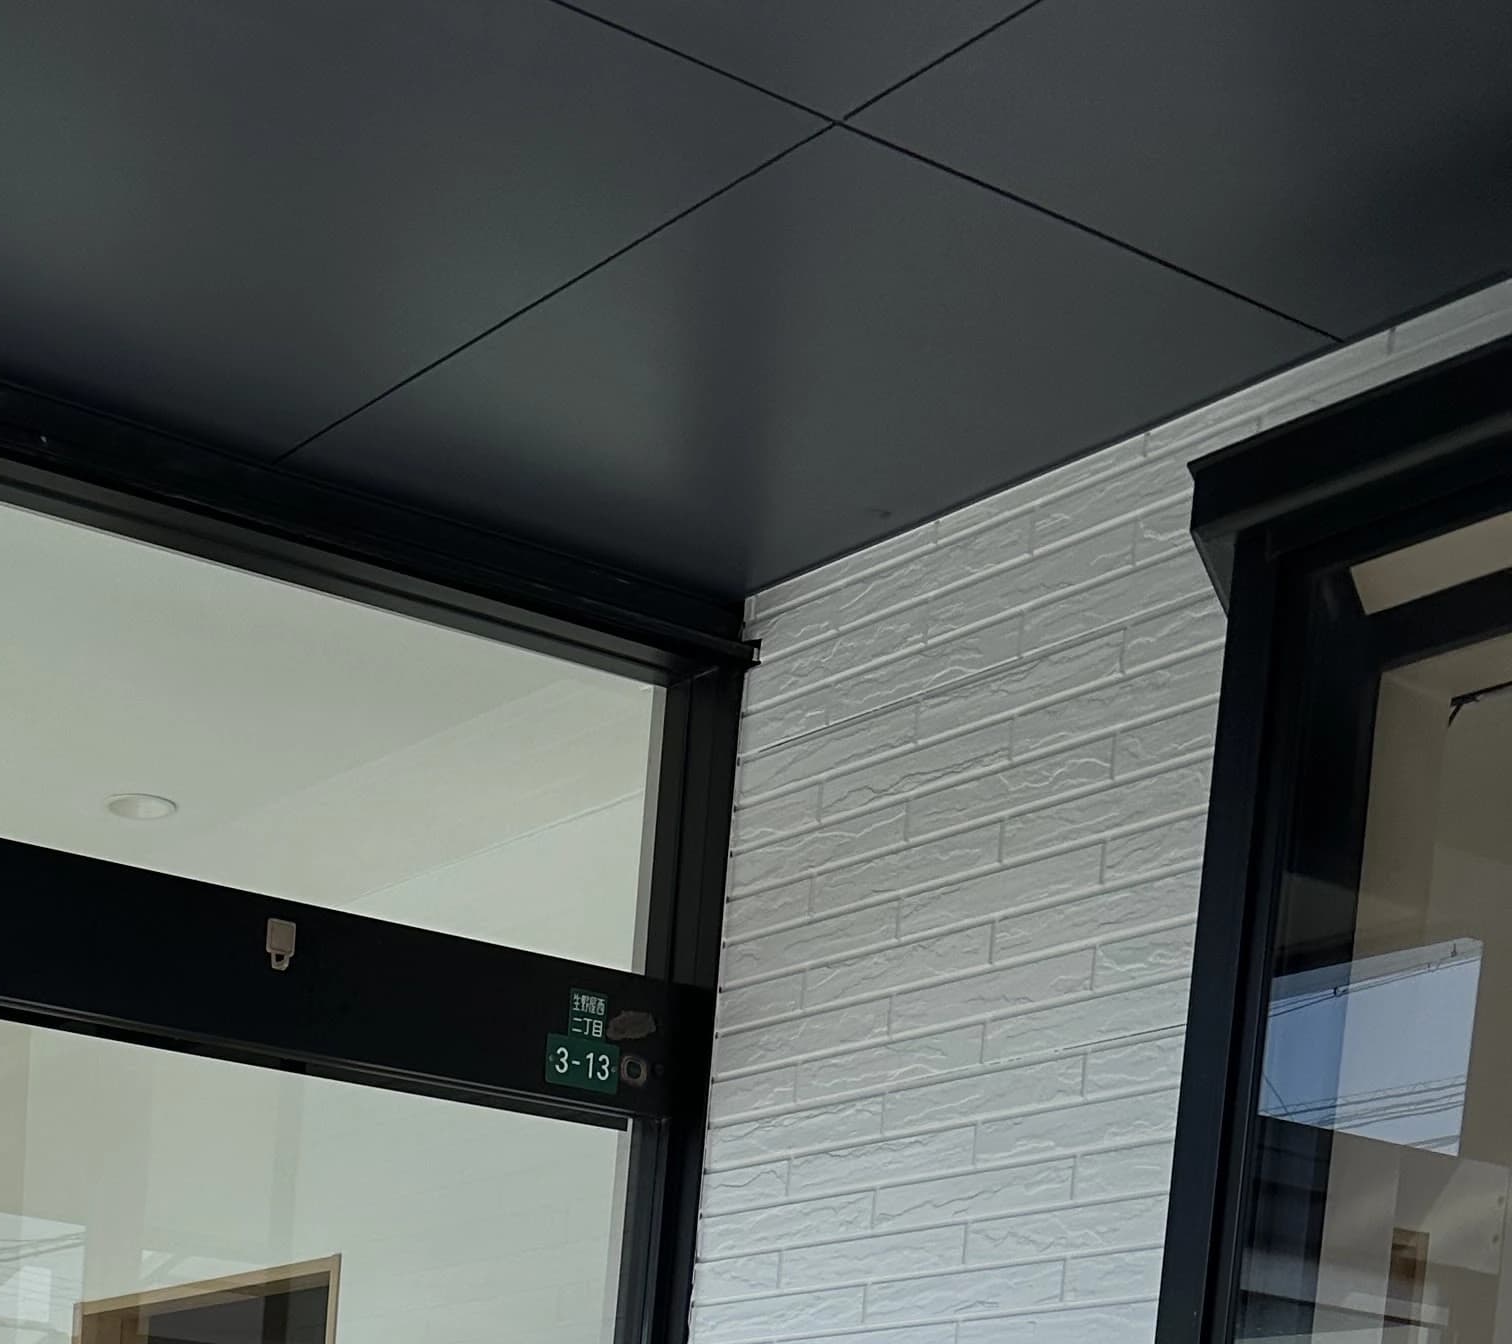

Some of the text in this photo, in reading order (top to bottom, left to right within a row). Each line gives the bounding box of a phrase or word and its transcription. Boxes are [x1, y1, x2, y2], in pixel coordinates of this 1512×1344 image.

[571, 1017, 603, 1038] 二丁目
[554, 1046, 610, 1081] 3-13
